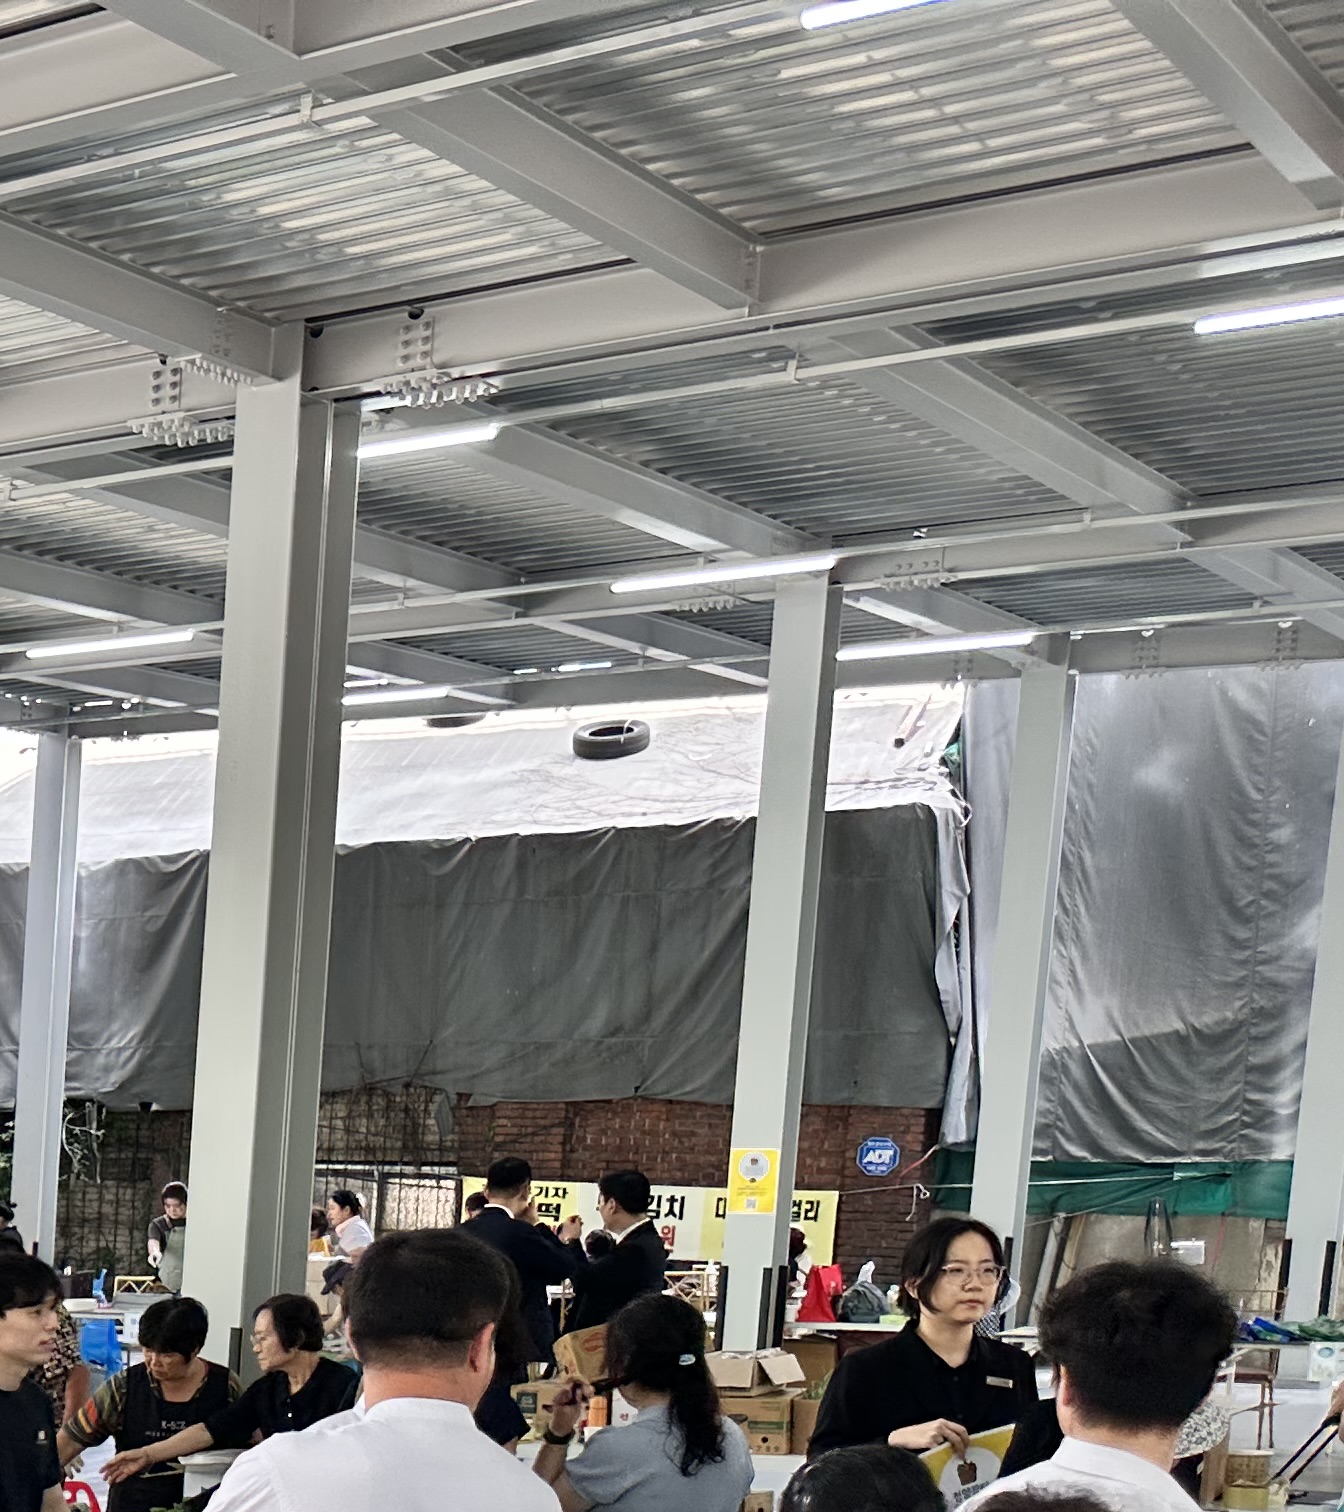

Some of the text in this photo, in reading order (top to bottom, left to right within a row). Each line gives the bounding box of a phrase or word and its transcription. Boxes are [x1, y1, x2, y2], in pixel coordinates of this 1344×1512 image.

[863, 1149, 894, 1164] ADT
[534, 1185, 569, 1200] 기자
[536, 1202, 562, 1222] 떡
